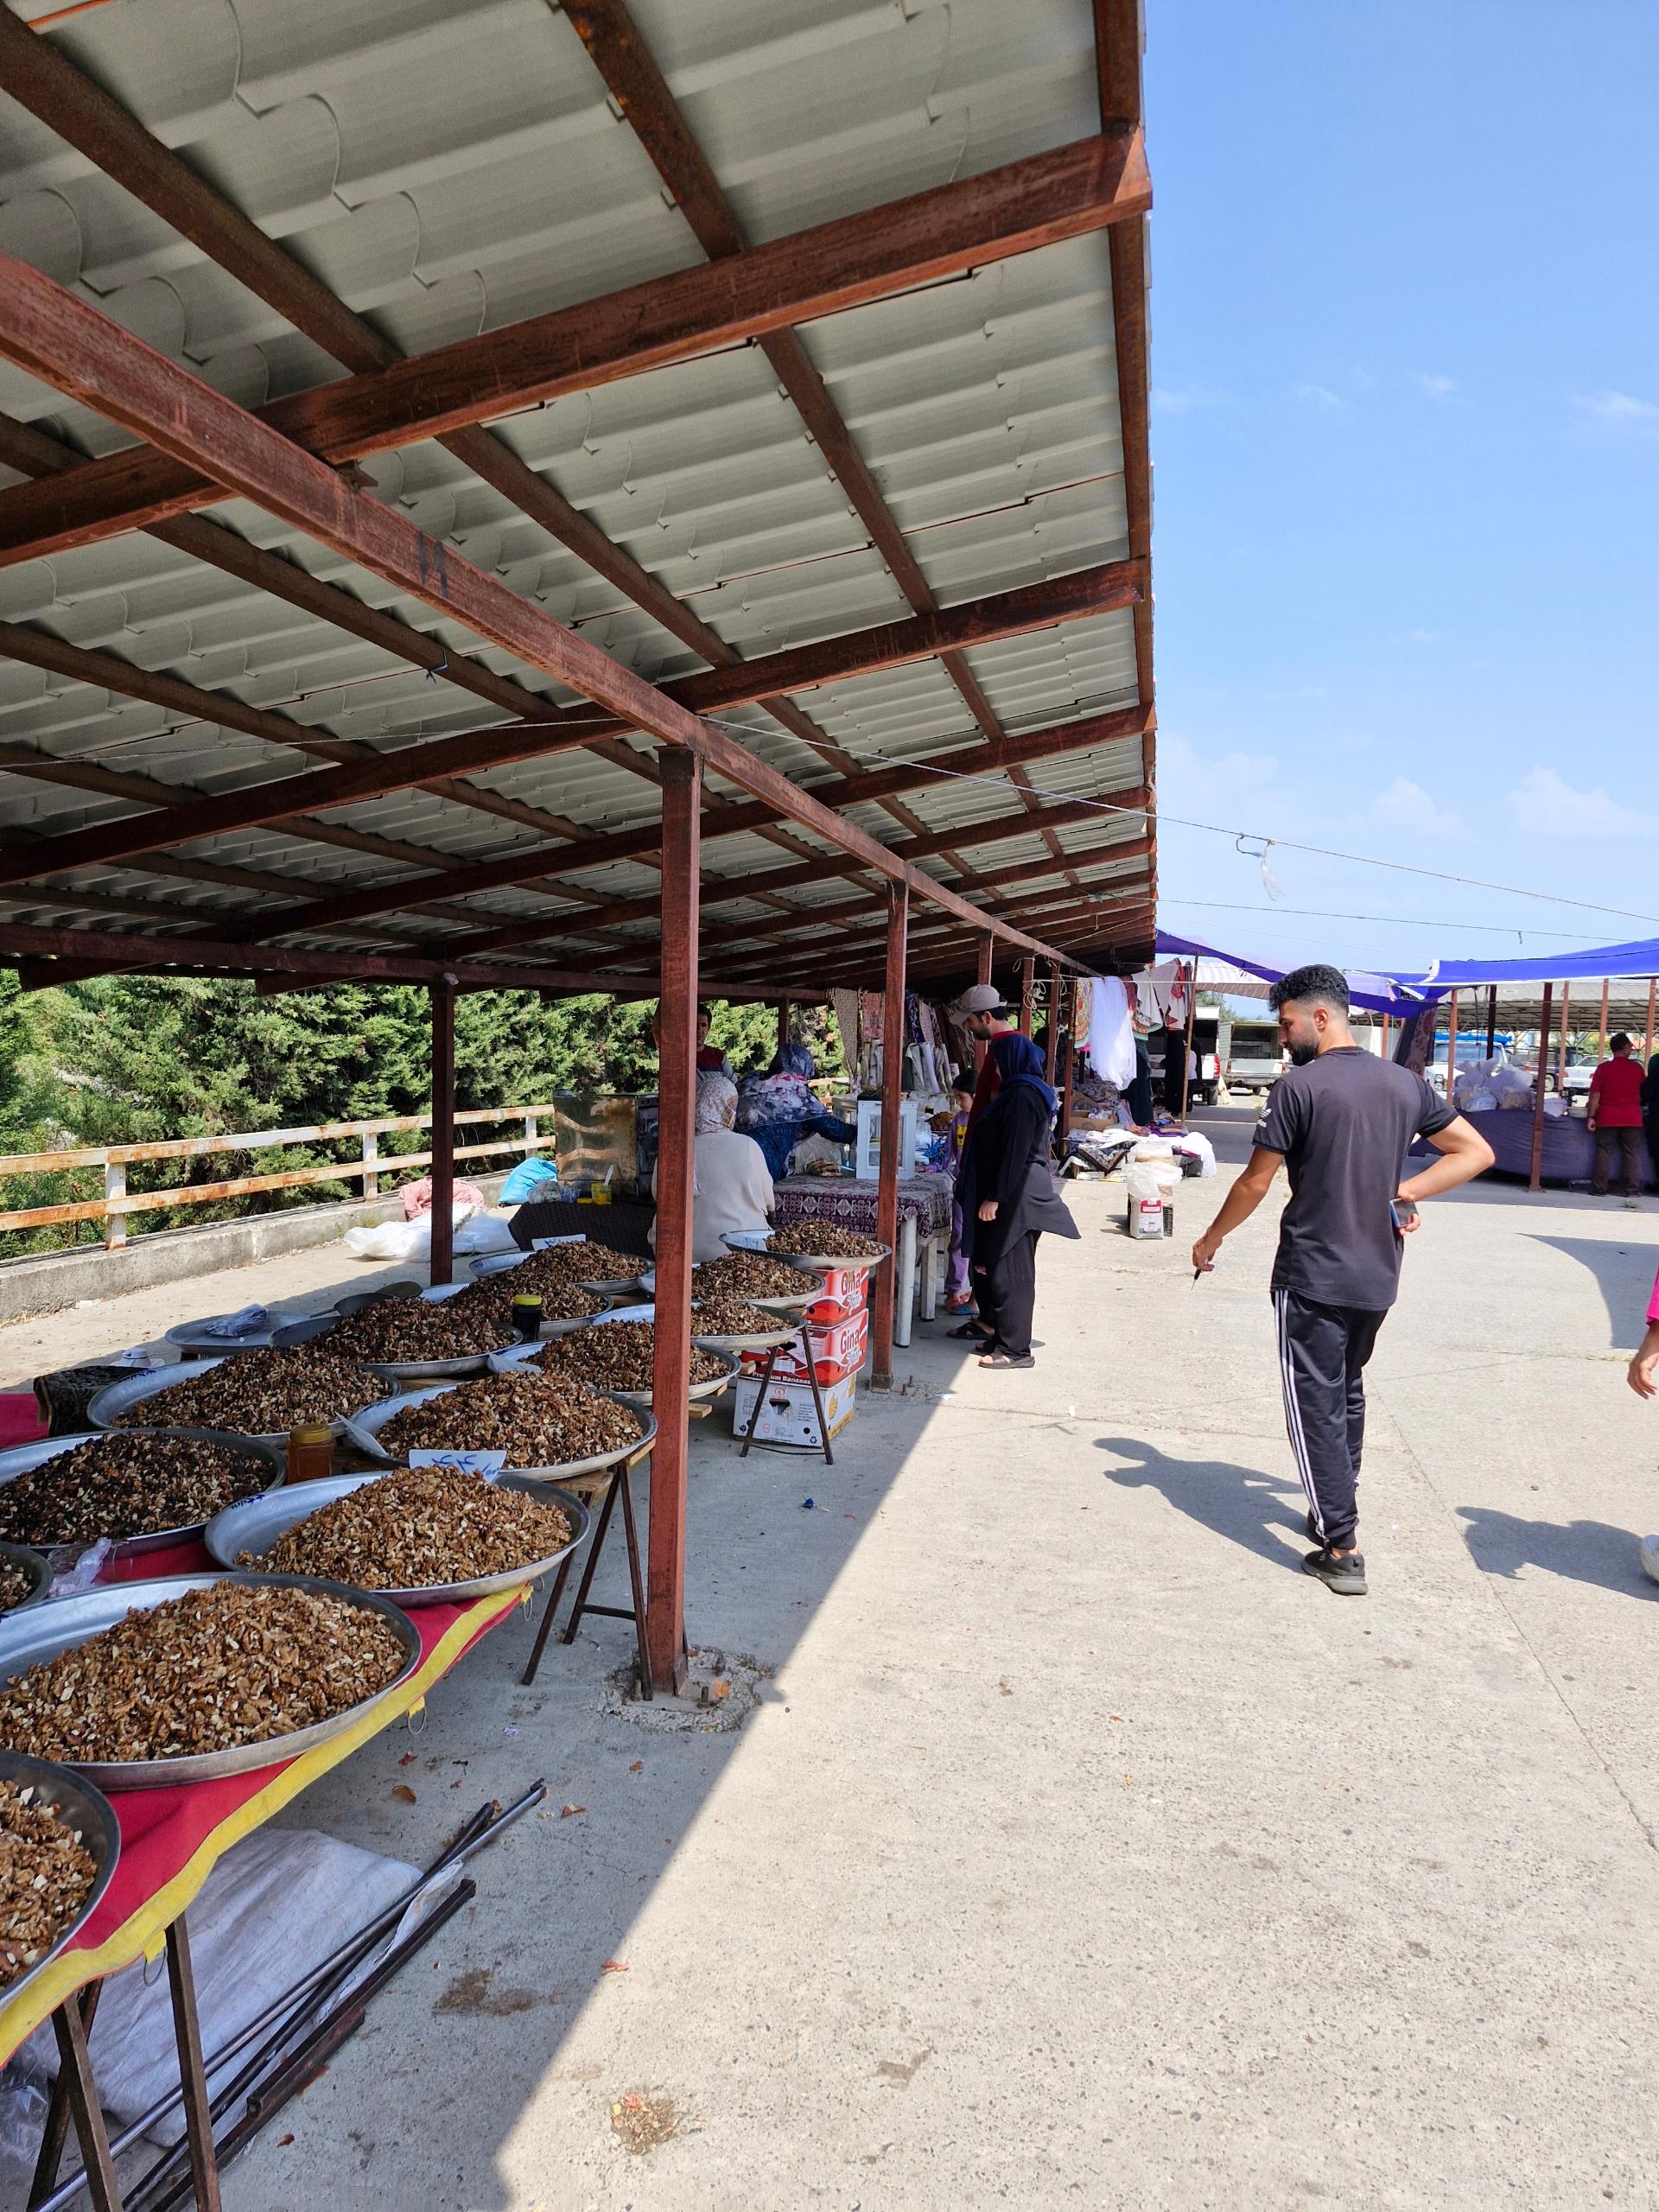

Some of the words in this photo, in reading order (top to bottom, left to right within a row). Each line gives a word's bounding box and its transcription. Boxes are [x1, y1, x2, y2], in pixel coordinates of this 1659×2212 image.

[840, 1328, 860, 1356] Gina
[752, 1370, 781, 1382] Preum
[782, 1375, 811, 1385] Bananas
